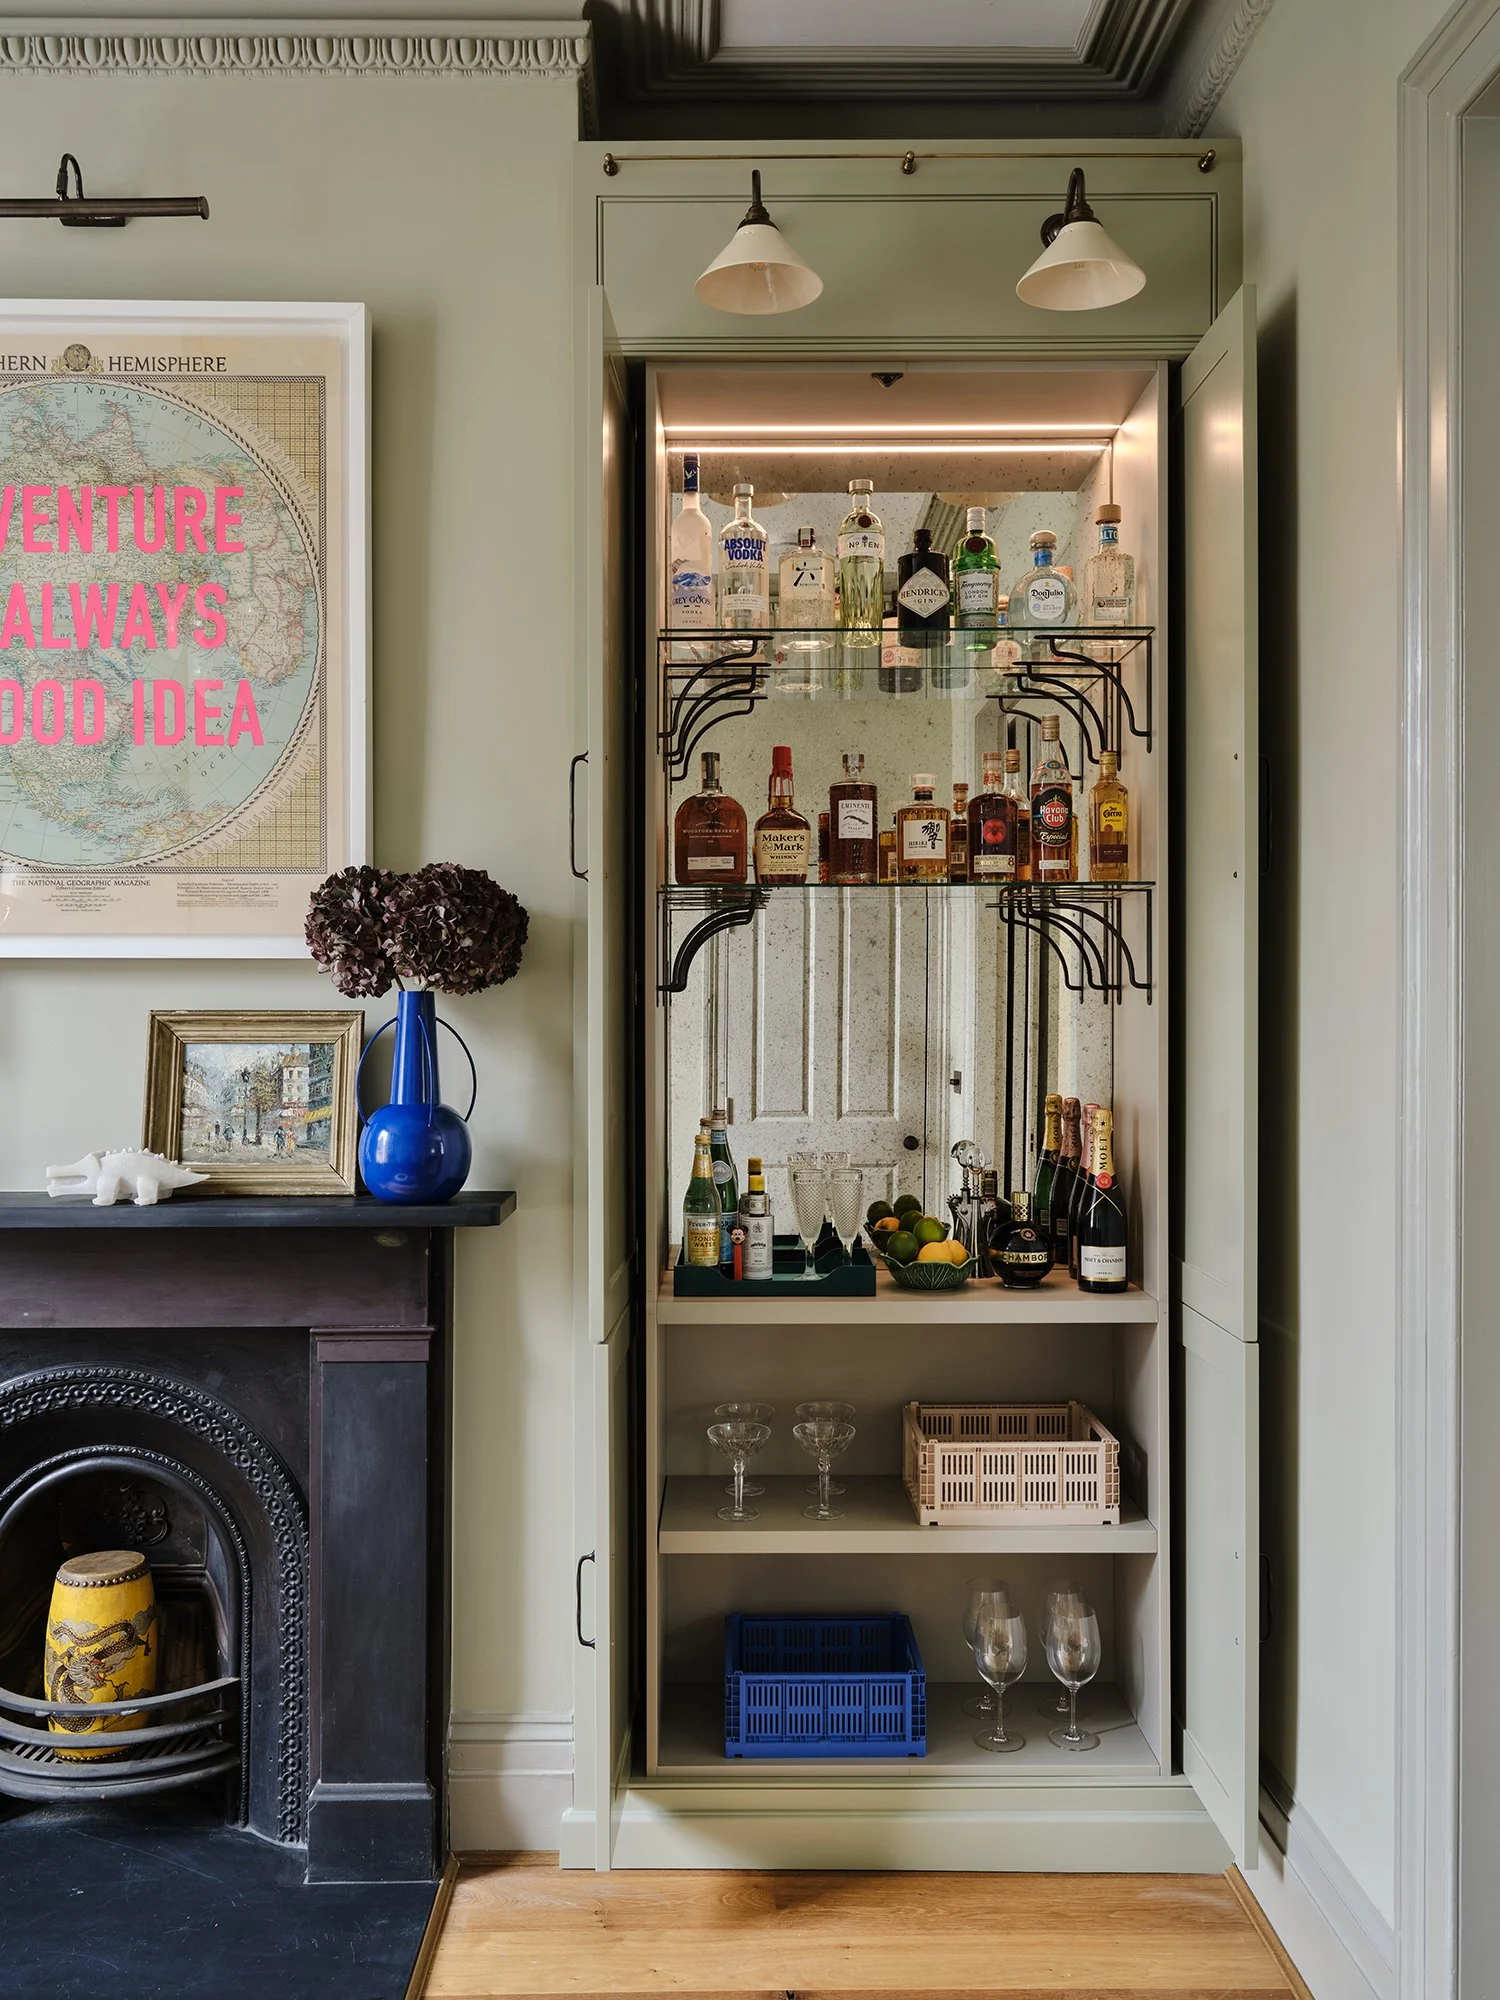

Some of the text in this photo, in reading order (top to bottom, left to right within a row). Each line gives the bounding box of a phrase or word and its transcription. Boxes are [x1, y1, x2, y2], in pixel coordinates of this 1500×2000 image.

[108, 356, 228, 373] HEMISPHERE
[73, 385, 216, 437] INDIAN OCEAN
[724, 537, 767, 552] ABSOLUT
[863, 541, 880, 549] TEN
[728, 550, 764, 562] VODKA
[0, 582, 228, 649] ALWAYS
[133, 679, 265, 746] IDEA
[1040, 806, 1069, 816] Havana
[1046, 814, 1064, 823] Club
[762, 834, 805, 842] Maker's
[774, 843, 804, 851] Mark
[1007, 856, 1015, 866] 8
